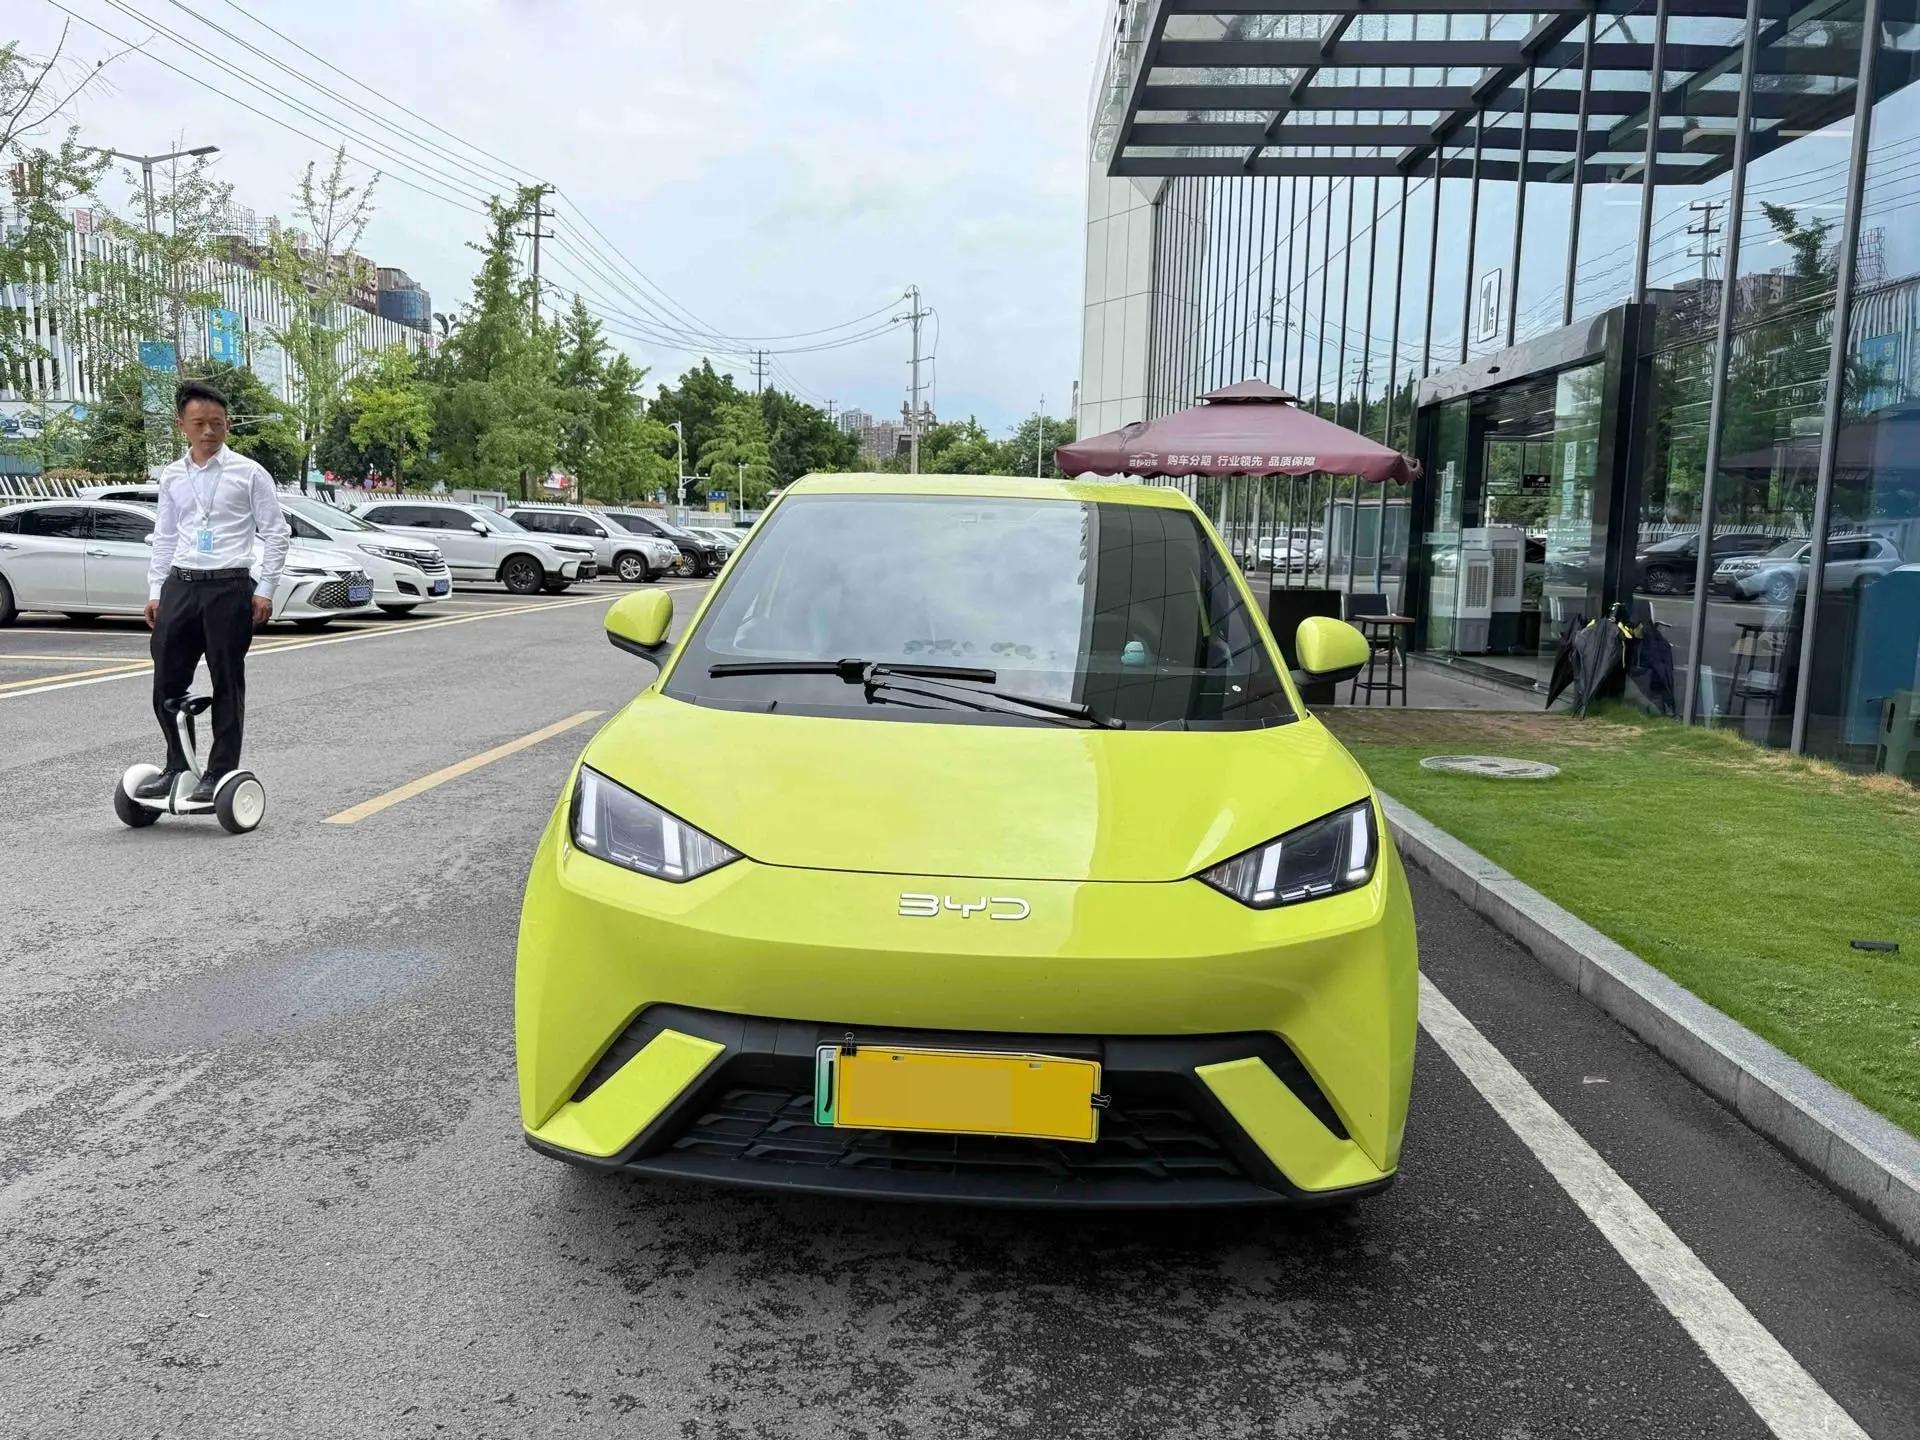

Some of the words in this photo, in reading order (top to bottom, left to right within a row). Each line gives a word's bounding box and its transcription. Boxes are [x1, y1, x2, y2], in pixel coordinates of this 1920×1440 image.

[1167, 454, 1212, 467] 购车分期
[1217, 454, 1263, 467] 行业领先
[1268, 455, 1316, 467] 品质保障
[898, 893, 1031, 920] BYD
